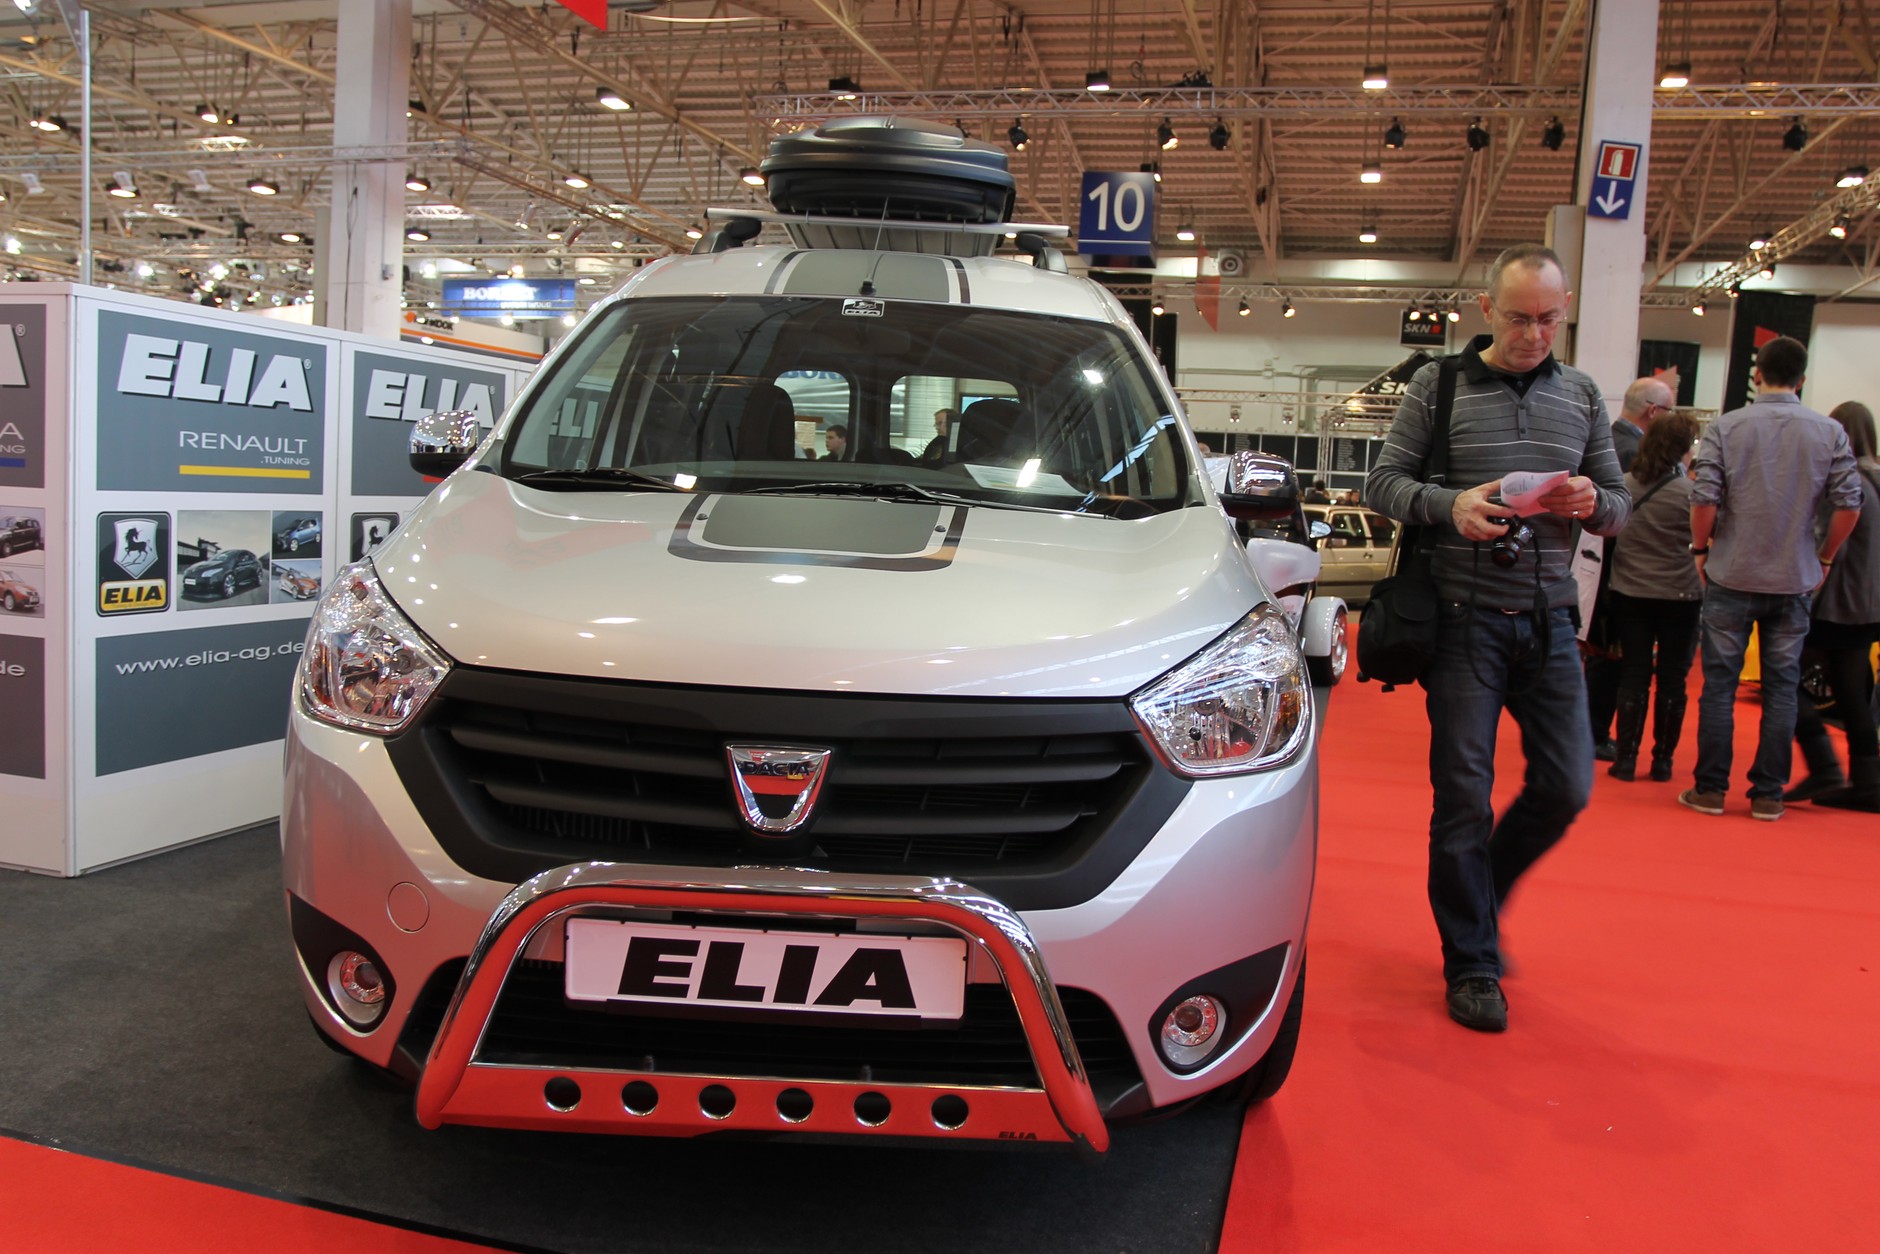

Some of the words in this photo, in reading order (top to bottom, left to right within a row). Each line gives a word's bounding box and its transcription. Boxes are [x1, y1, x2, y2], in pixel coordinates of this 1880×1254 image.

[1088, 181, 1145, 232] 10
[463, 286, 537, 300] BOT
[1404, 323, 1431, 333] SKN
[1379, 382, 1408, 395] SK
[179, 430, 308, 454] RENAULT
[104, 585, 162, 604] ELIA
[115, 641, 305, 675] www.elia-ag.de
[743, 761, 810, 776] DACIA
[617, 936, 916, 1008] ELIA
[998, 1131, 1037, 1140] ELIA
